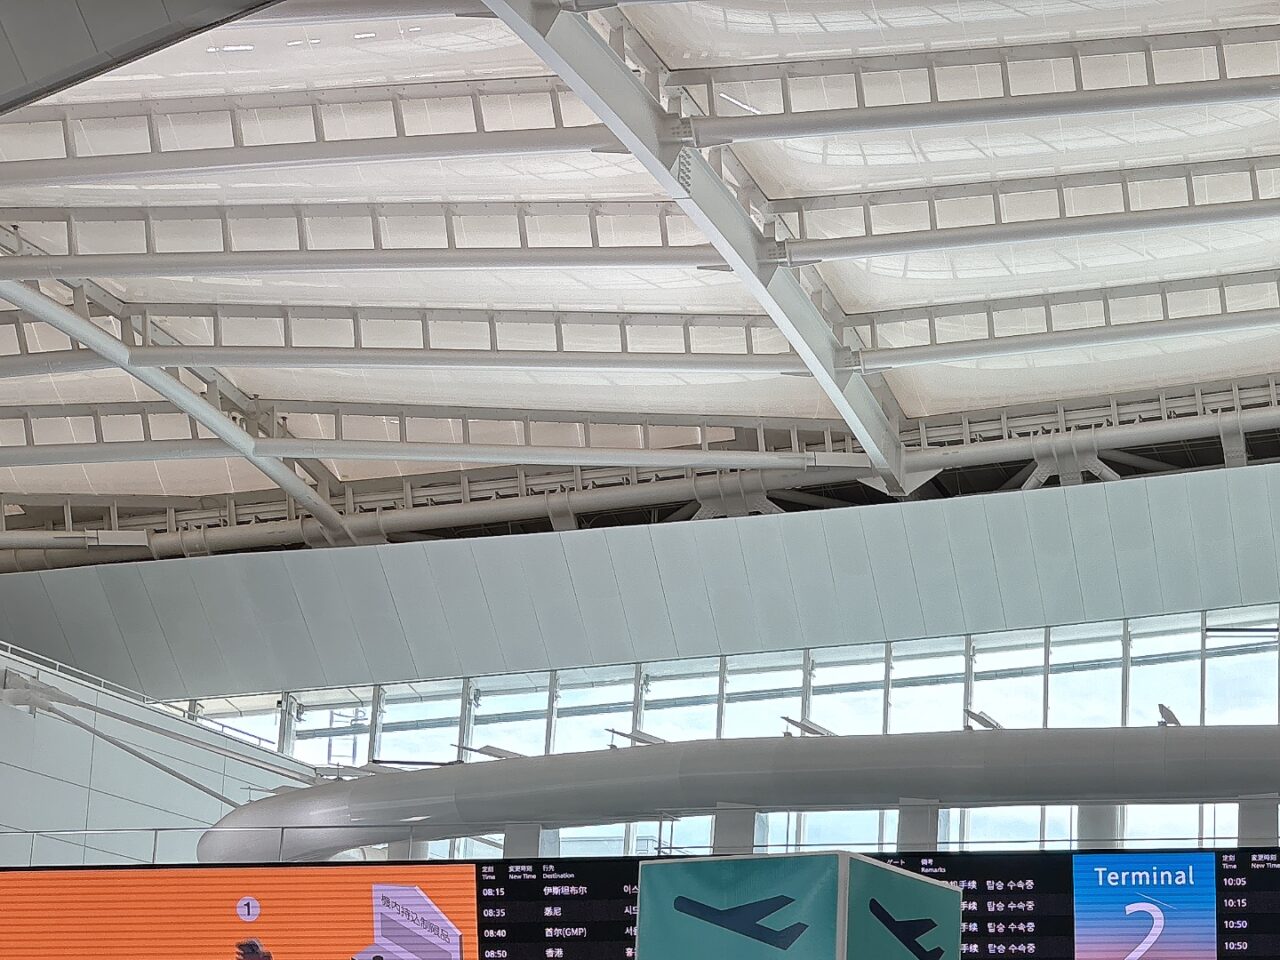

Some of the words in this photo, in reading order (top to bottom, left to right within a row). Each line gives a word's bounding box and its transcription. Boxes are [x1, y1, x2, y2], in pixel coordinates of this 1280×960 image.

[1094, 866, 1194, 886] Terminal
[1223, 877, 1247, 886] 10:05
[482, 888, 505, 896] 08:15
[1224, 898, 1247, 908] 10:15
[244, 902, 250, 916] 1
[483, 909, 506, 917] 08:35
[1224, 920, 1248, 928] 10:50
[484, 930, 506, 938] 08:40
[1224, 941, 1248, 950] 10:50
[485, 950, 507, 958] 08:50
